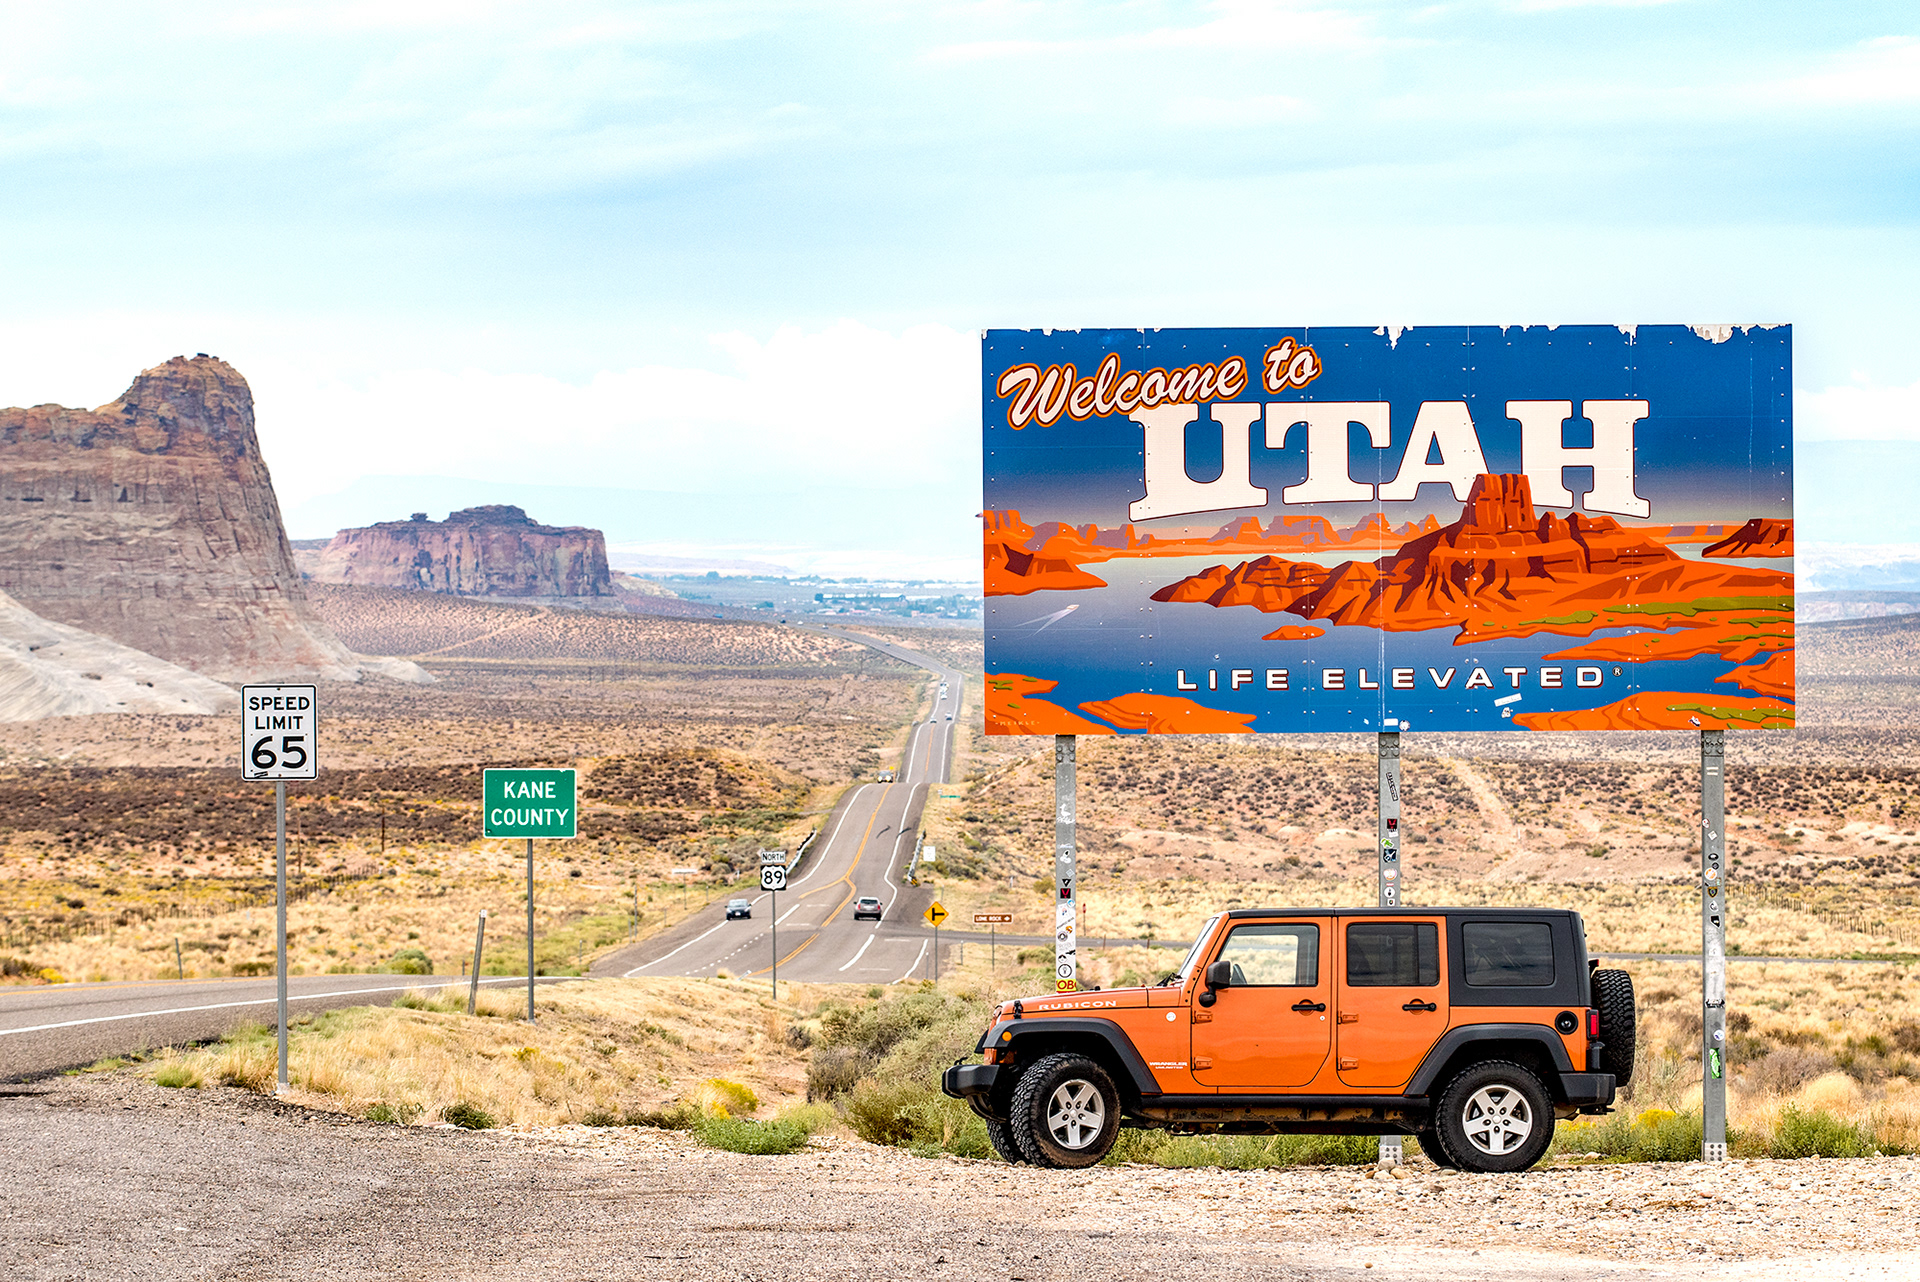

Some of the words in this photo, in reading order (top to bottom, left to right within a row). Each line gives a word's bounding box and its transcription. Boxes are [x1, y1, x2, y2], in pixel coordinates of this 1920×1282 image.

[998, 353, 1247, 429] Welcome
[1262, 337, 1322, 393] to
[1128, 399, 1650, 520] UTAH
[1176, 668, 1289, 691] LIFE
[249, 697, 310, 711] SPEED
[255, 716, 303, 729] LIMIT
[251, 736, 307, 769] 65
[504, 781, 556, 798] KANE
[491, 808, 569, 826] COUNTY
[764, 871, 782, 884] 89
[1039, 1000, 1117, 1010] RUBICON
